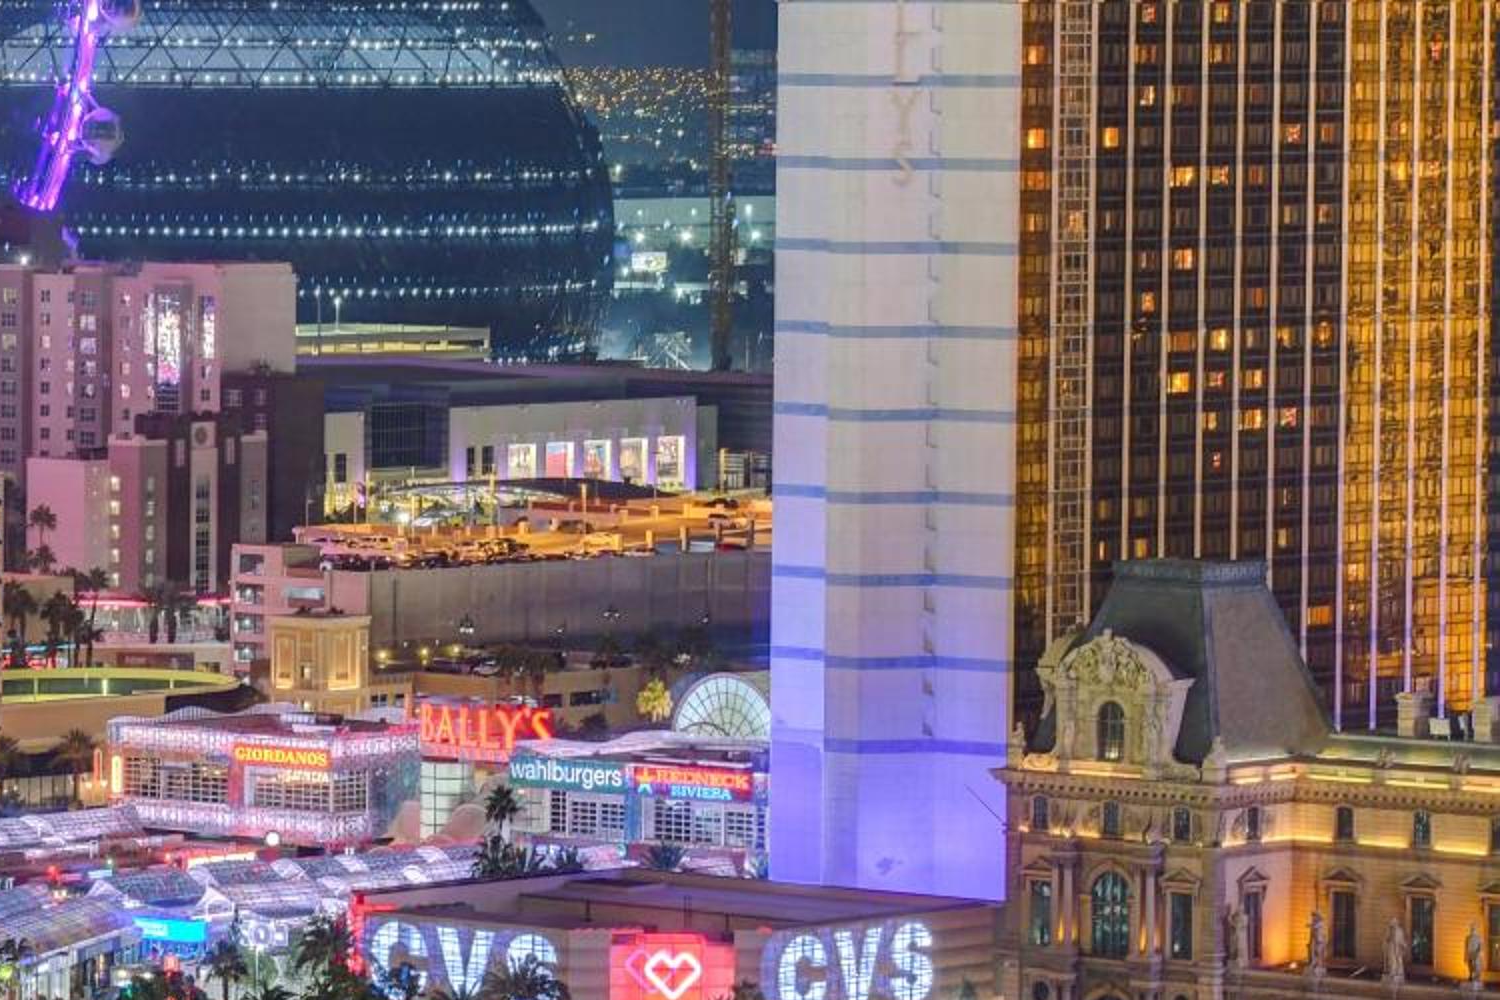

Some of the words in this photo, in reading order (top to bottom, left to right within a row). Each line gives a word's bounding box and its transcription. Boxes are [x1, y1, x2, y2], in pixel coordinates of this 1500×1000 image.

[420, 702, 552, 750] BALLY'S
[509, 760, 623, 789] wahlburgers
[656, 769, 749, 789] REDNECK
[670, 785, 732, 800] RIVIERA
